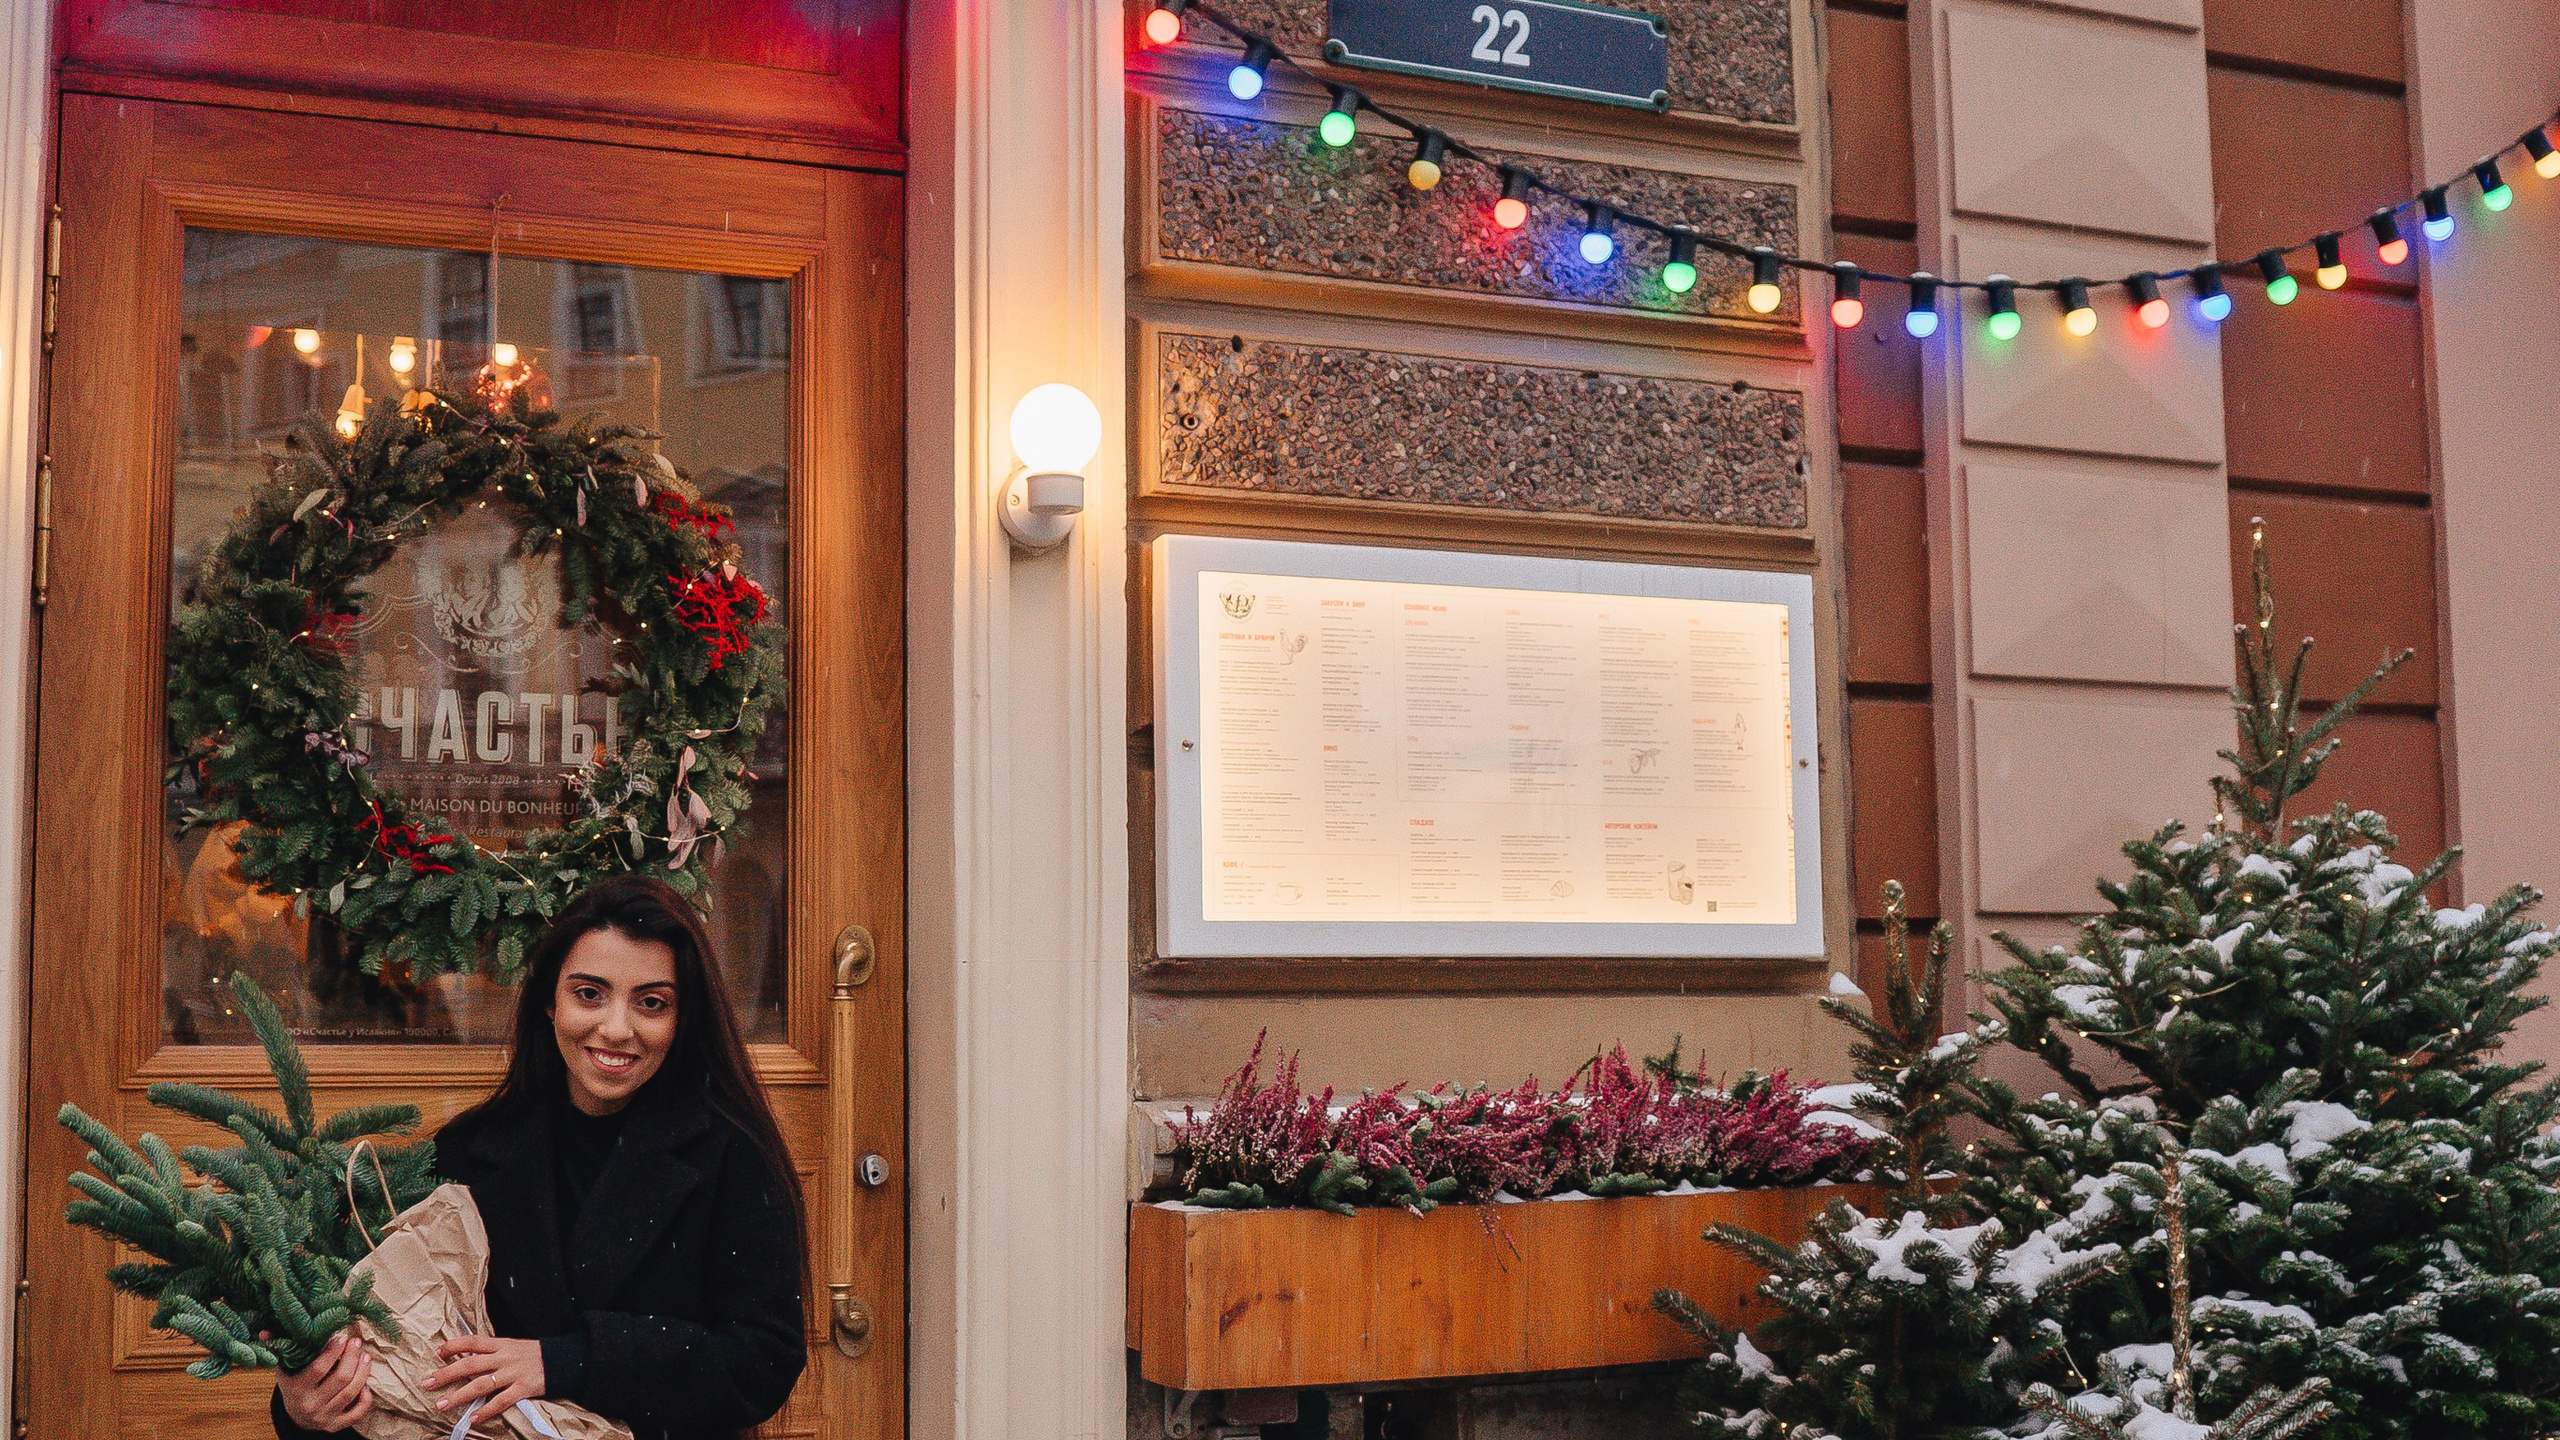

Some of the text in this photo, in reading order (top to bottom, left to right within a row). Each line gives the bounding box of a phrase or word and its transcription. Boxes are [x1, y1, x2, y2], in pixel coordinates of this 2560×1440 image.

[1471, 4, 1531, 67] 22
[490, 774, 520, 786] 2008
[410, 798, 475, 813] MAISON
[479, 800, 503, 814] DU
